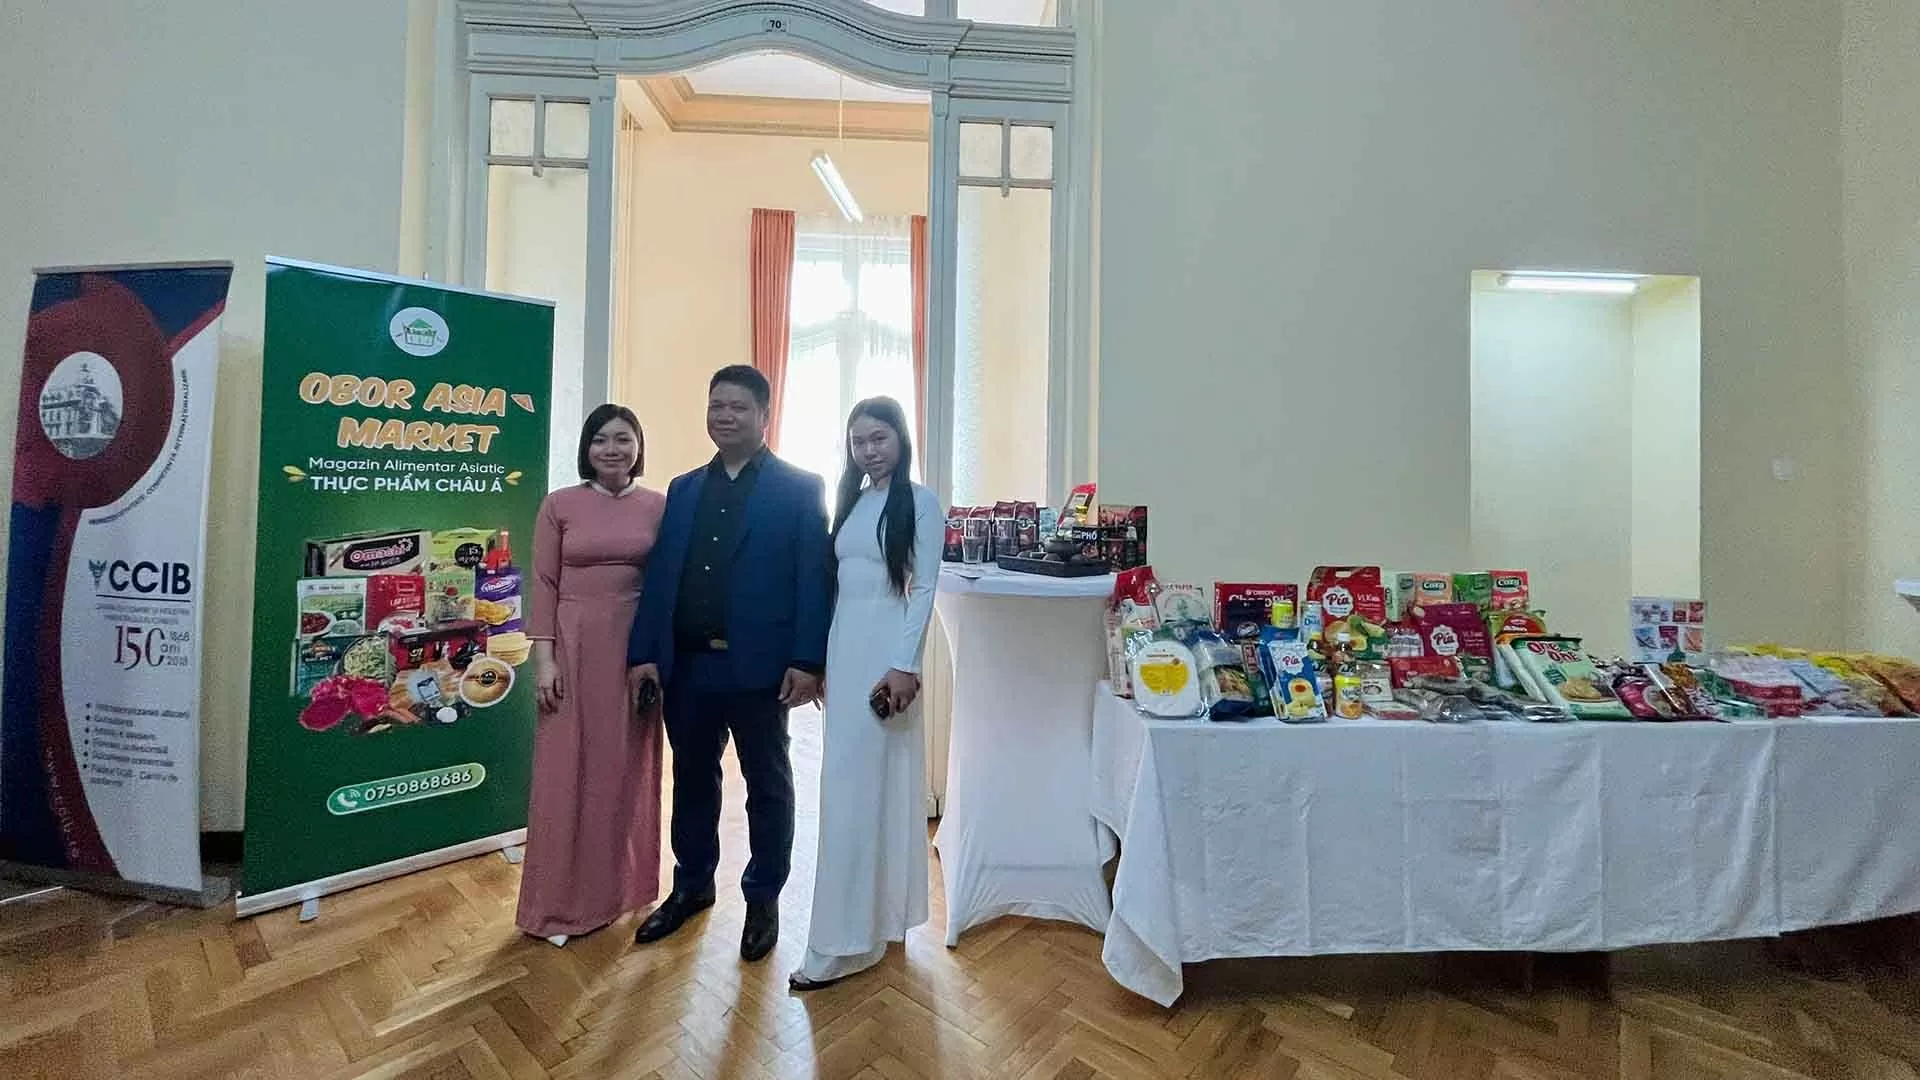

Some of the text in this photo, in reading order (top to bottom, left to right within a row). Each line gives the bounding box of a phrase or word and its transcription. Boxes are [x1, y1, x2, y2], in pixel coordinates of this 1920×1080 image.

[769, 19, 782, 29] 70
[300, 372, 507, 416] OBOR ASIA
[337, 416, 500, 453] MARKET
[309, 457, 505, 474] Magazin Alimentar Asiatic
[310, 473, 503, 494] THỰC PHẨM CHÂU Á
[108, 560, 192, 595] CCIB
[364, 768, 472, 801] 0750868686
